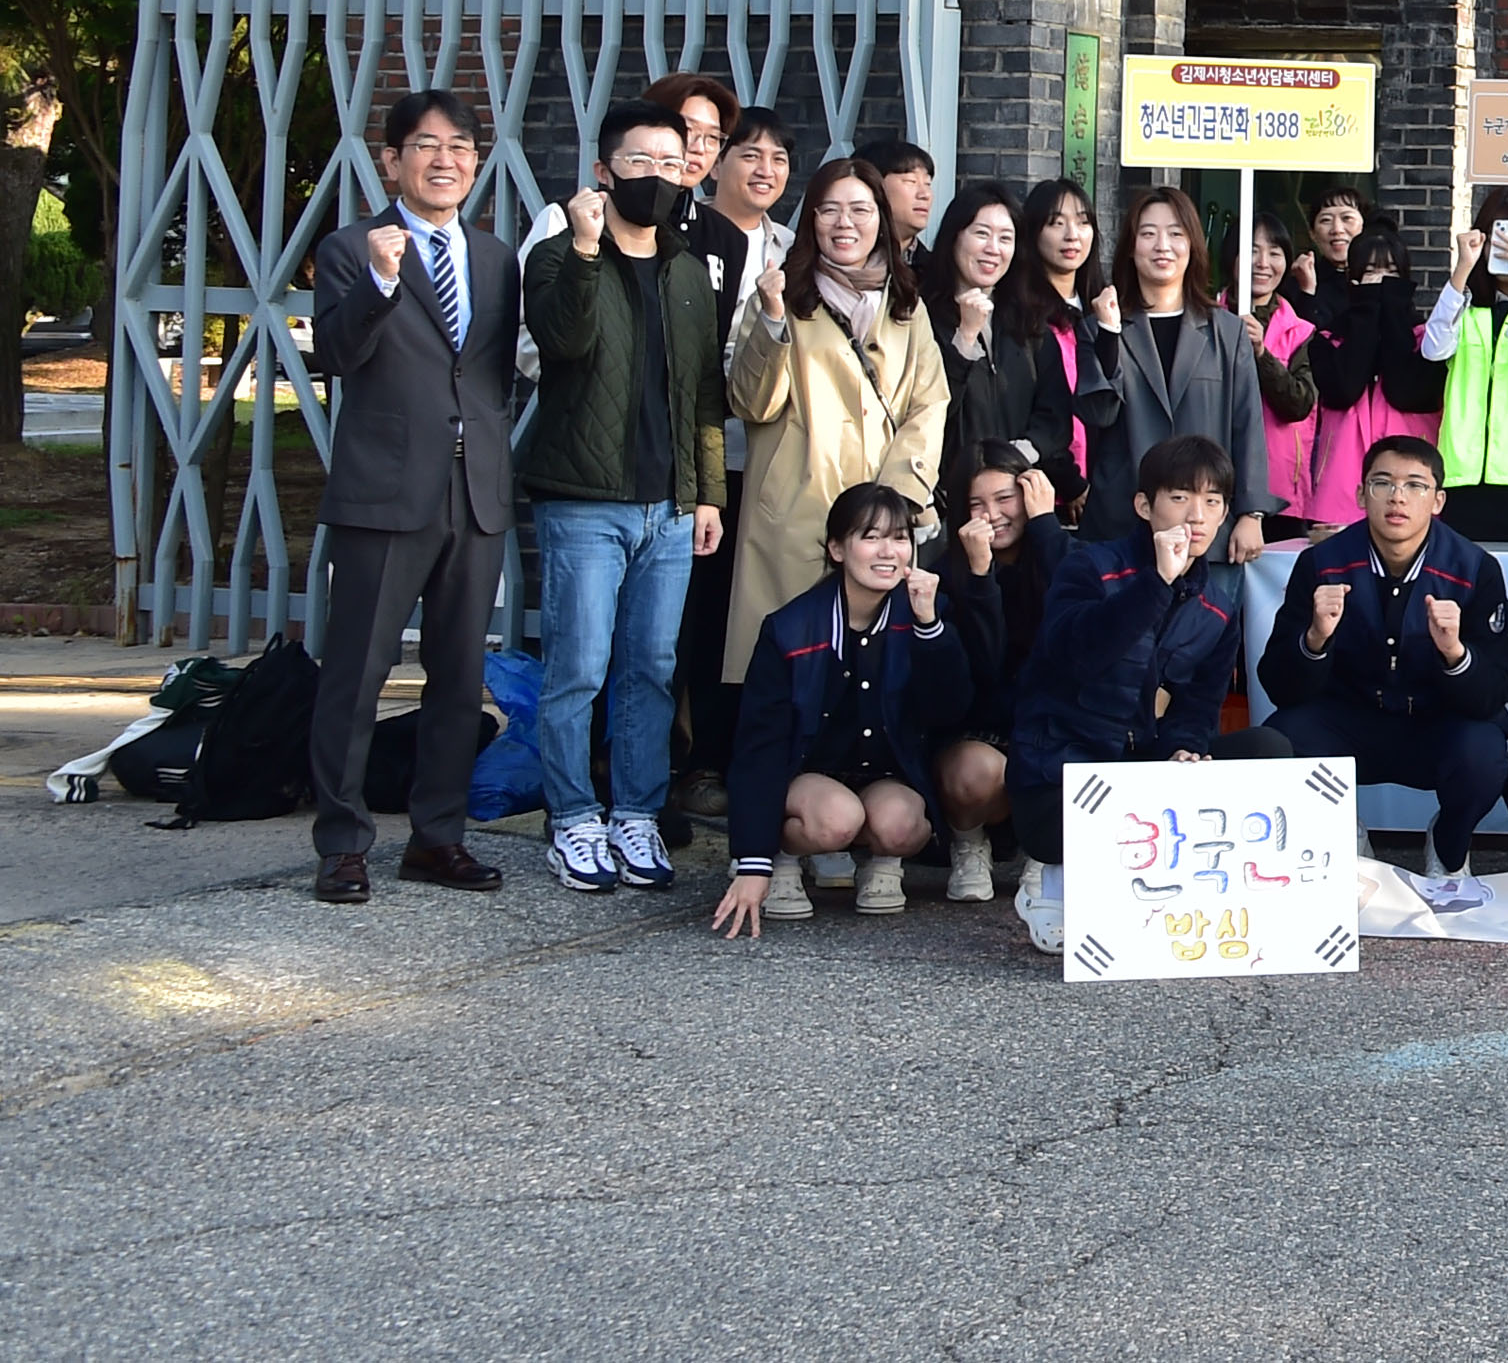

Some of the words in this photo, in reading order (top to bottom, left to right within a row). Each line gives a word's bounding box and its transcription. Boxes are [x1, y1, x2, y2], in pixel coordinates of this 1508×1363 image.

[1180, 65, 1334, 87] 김제시청소년상담복지센터
[1140, 103, 1250, 140] 청소년긴급전화
[1255, 112, 1299, 138] 1388
